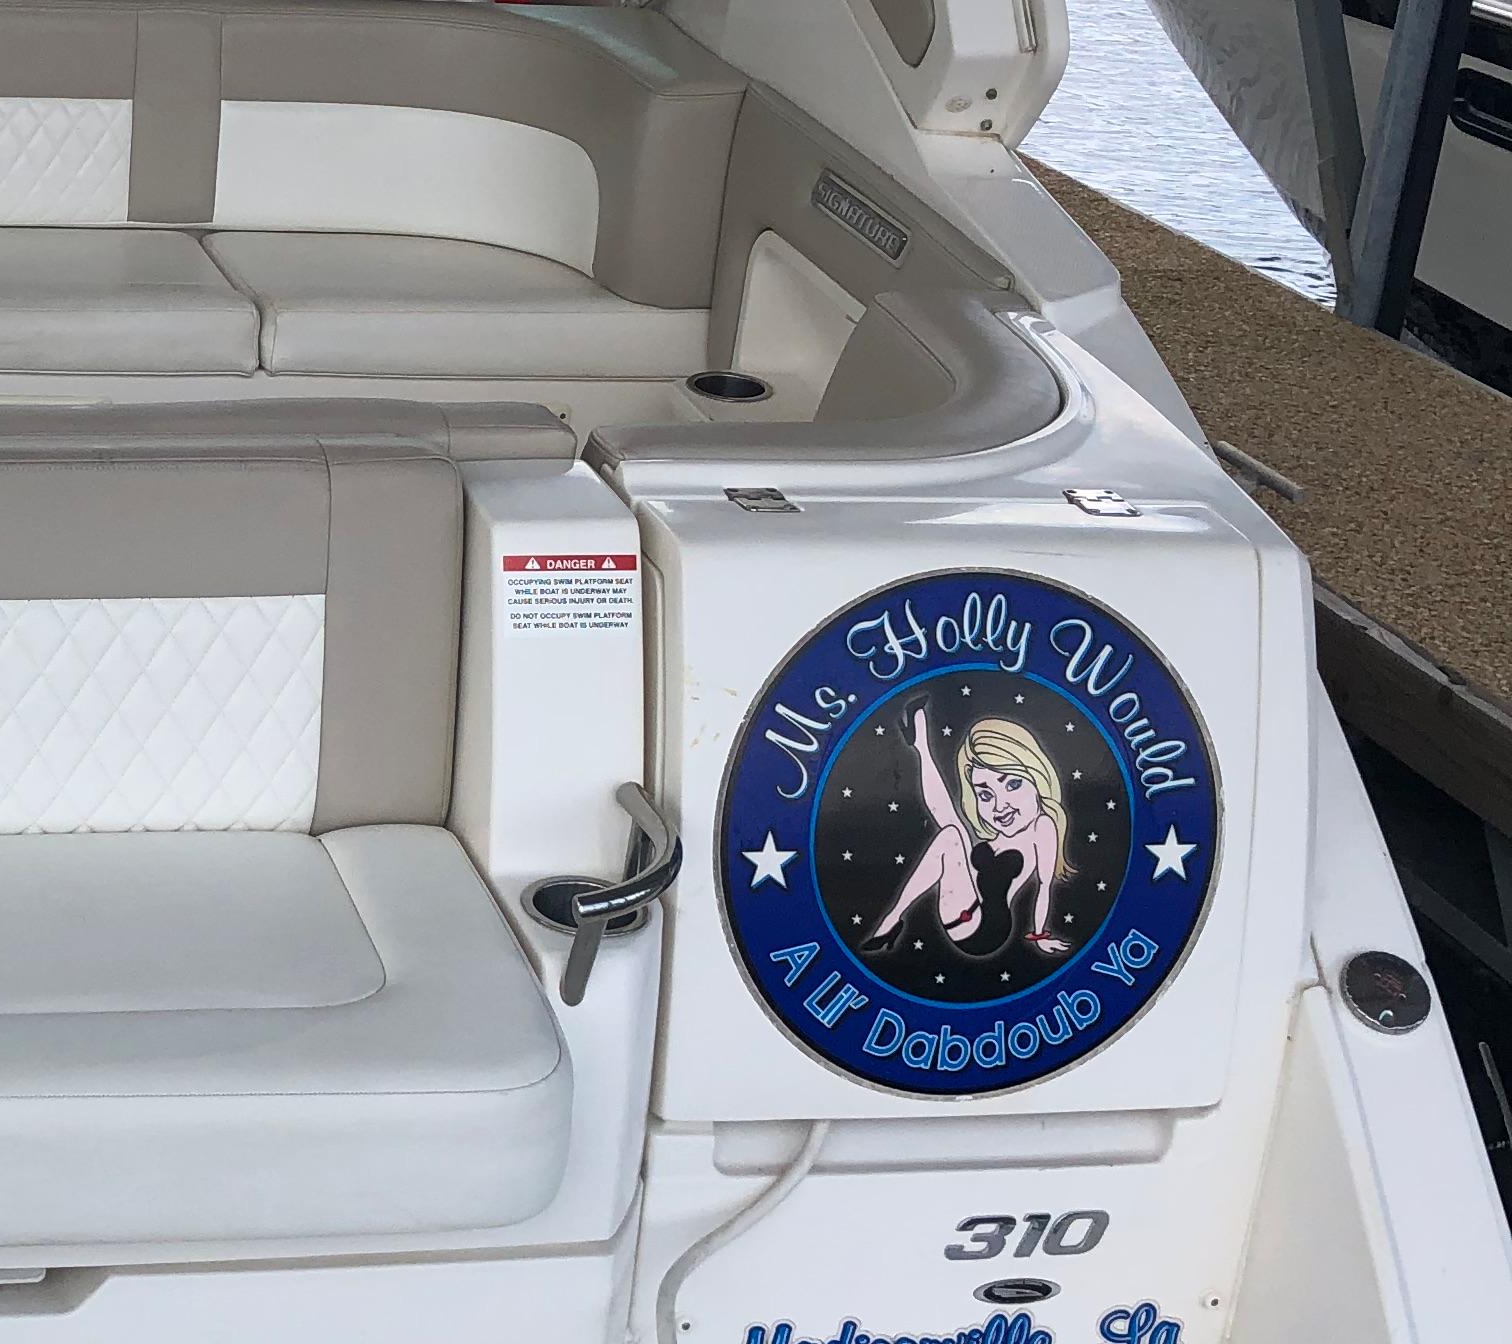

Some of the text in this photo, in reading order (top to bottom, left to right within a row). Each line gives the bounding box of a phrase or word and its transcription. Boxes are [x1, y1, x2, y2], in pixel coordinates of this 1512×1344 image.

[818, 182, 900, 254] SIGNATURE
[508, 578, 633, 586] OCCUPYING SWIM PLATFORM SEAT
[546, 559, 596, 569] DANGER
[510, 612, 633, 620] DO NOT OCCUPY SWIM PLATFORM
[765, 592, 1196, 801] Ms. Holly Would
[770, 941, 821, 986] A
[862, 988, 1101, 1072] Dabdoub
[1091, 928, 1160, 987] Ya
[944, 1209, 1110, 1261] 310
